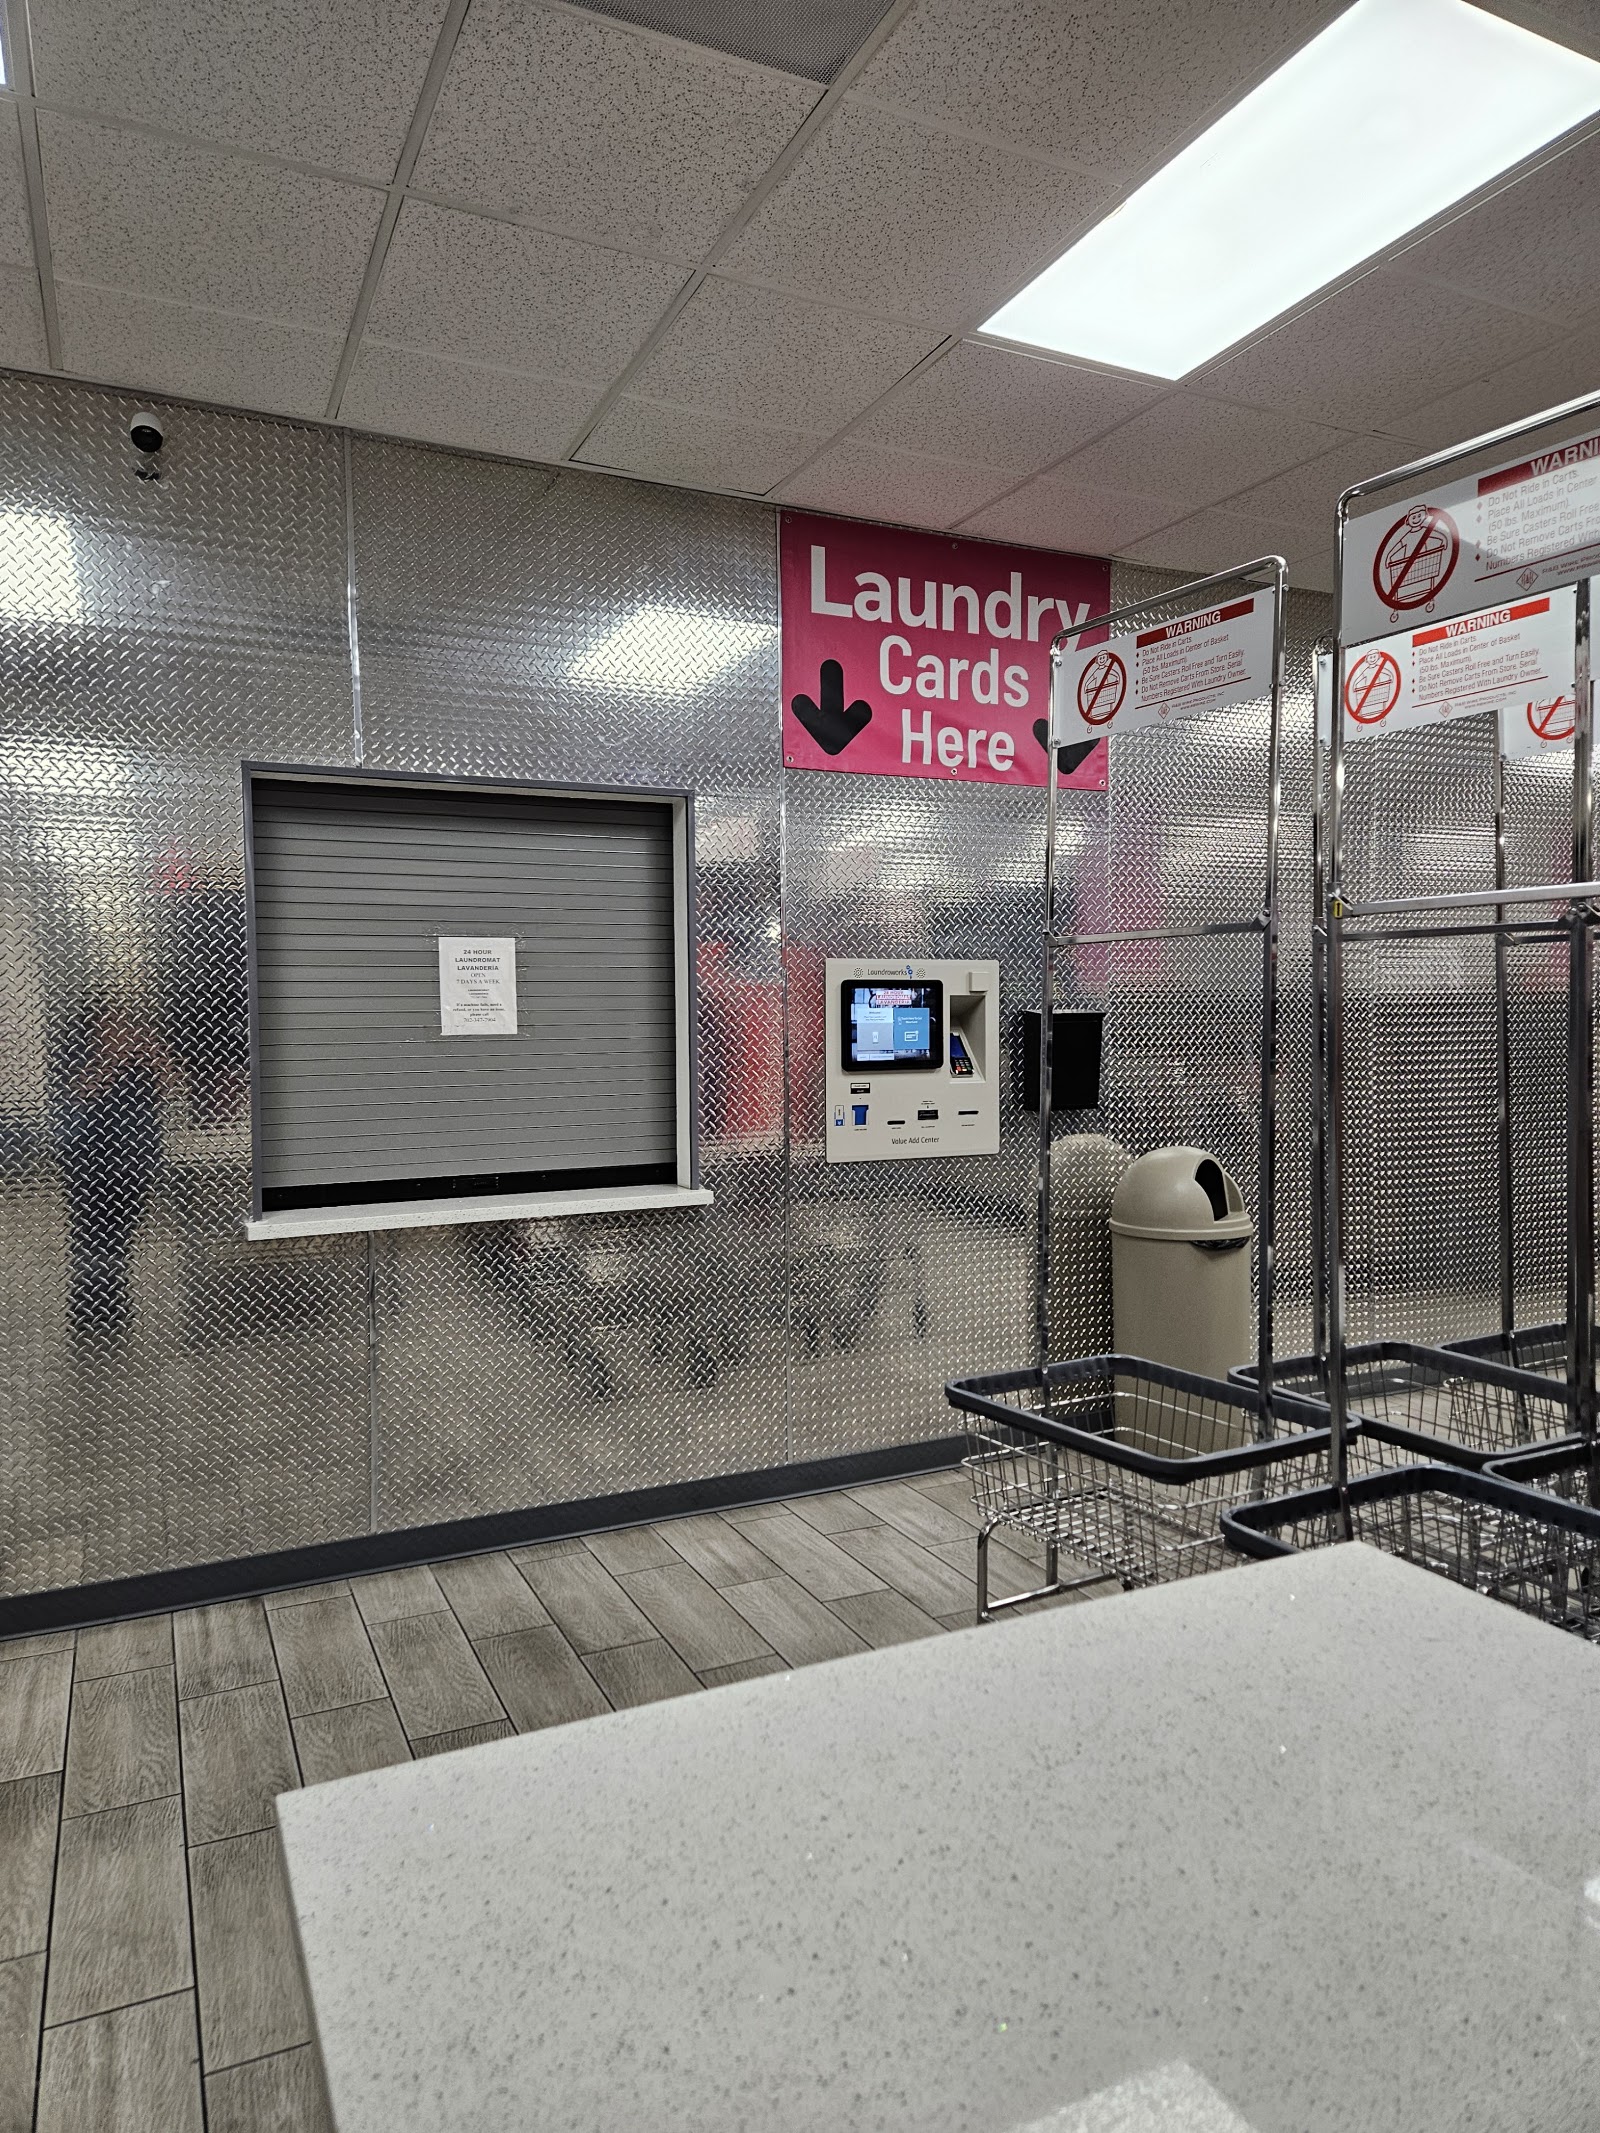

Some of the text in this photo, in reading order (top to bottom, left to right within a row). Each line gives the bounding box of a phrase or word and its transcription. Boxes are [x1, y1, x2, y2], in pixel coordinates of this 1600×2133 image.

[1530, 438, 1600, 476] WARNI
[1488, 496, 1500, 507] Do
[1502, 490, 1518, 502] Not
[1521, 482, 1540, 496] Ride
[1542, 480, 1550, 488] in
[1488, 476, 1597, 520] Place All Loads in Center
[1486, 516, 1600, 558] Do Not Remove Carts Fro
[1487, 502, 1600, 546] Be Sure Casters Roll Free
[1488, 521, 1502, 534] (50
[1486, 553, 1524, 571] Numbers
[1527, 537, 1575, 558] Registered
[810, 545, 1090, 651] Laundry
[1165, 610, 1221, 638] WARNING
[1445, 610, 1511, 638] WARNING
[1142, 657, 1155, 666] Place
[1164, 651, 1179, 660] Loads
[1186, 643, 1202, 652] Center
[1211, 634, 1229, 645] Basket
[1150, 646, 1159, 655] Not
[1160, 643, 1171, 652] Ride
[1419, 656, 1434, 666] Place
[1444, 649, 1462, 659] Loads
[1469, 642, 1489, 652] Center
[1491, 638, 1498, 647] of
[1499, 633, 1521, 644] Basket
[1440, 642, 1452, 651] Ride
[880, 635, 1029, 707] Cards
[1149, 673, 1160, 683] Sure
[1161, 668, 1181, 680] Casters
[1181, 664, 1191, 673] Roll
[1192, 661, 1203, 672] Free
[1204, 657, 1215, 666] and
[1216, 654, 1227, 663] Turn
[1149, 683, 1158, 692] Not
[1159, 677, 1180, 689] Remove
[1181, 673, 1194, 682] Carts
[1196, 668, 1209, 678] From
[1227, 659, 1242, 670] Serial
[1418, 675, 1426, 684] Be
[1427, 672, 1440, 682] Sure
[1441, 666, 1463, 678] Casters
[1465, 661, 1476, 670] Roll
[1478, 659, 1490, 668] Free
[1492, 654, 1504, 664] and
[1505, 651, 1520, 661] Turn
[1418, 685, 1426, 693] Do
[1427, 682, 1438, 691] Not
[1440, 676, 1463, 687] Remove
[1464, 671, 1480, 681] Carts
[1482, 667, 1498, 678] From
[1520, 657, 1537, 668] Serial
[1142, 692, 1163, 702] Numbers
[1163, 683, 1191, 698] Registered
[1191, 680, 1203, 689] With
[1204, 673, 1226, 686] Laundry
[1418, 689, 1444, 701] Numbers
[1445, 681, 1476, 698] Registered
[1476, 678, 1491, 687] With
[1492, 672, 1518, 685] Laundry
[902, 708, 1015, 771] Here
